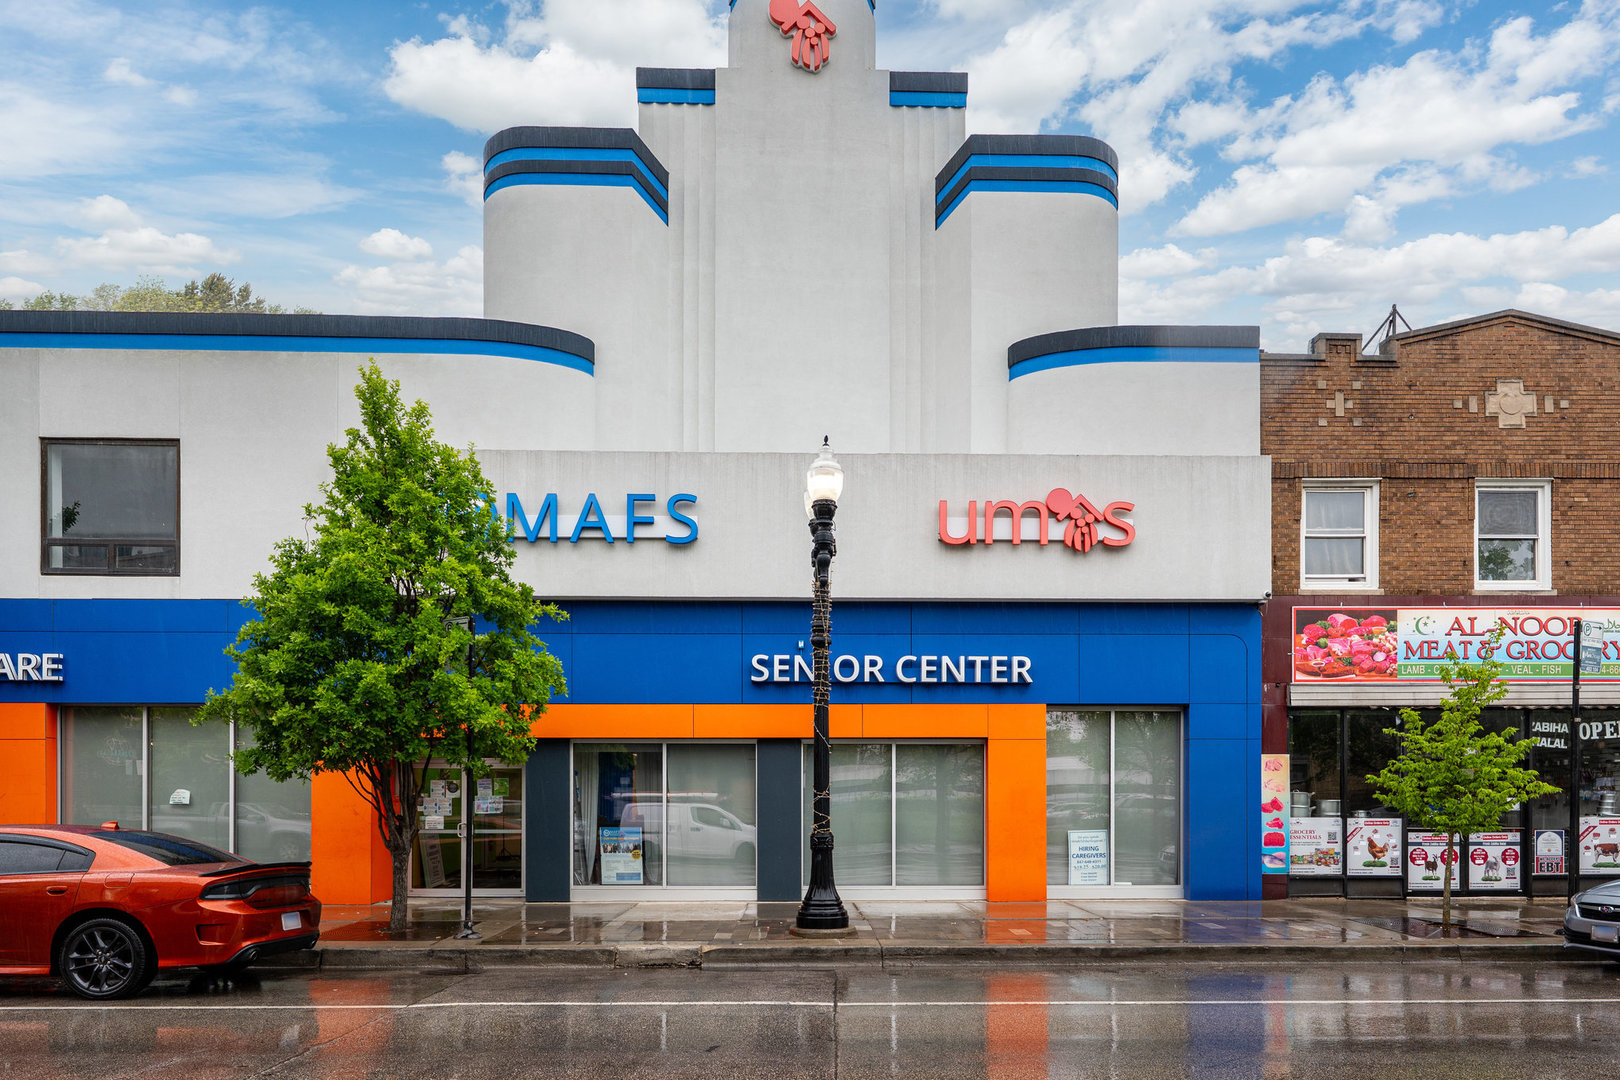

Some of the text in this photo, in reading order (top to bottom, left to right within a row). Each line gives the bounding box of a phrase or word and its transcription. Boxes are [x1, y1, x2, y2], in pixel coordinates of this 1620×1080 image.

[1403, 640, 1473, 660] MEAT
[1476, 640, 1502, 660] &
[751, 654, 1033, 683] SENOR CENTER
[1401, 665, 1425, 674] LAMB
[1511, 665, 1533, 674] VEAL
[1541, 665, 1561, 674] FISH
[1579, 721, 1620, 740] OPE
[1540, 862, 1561, 872] EBT
